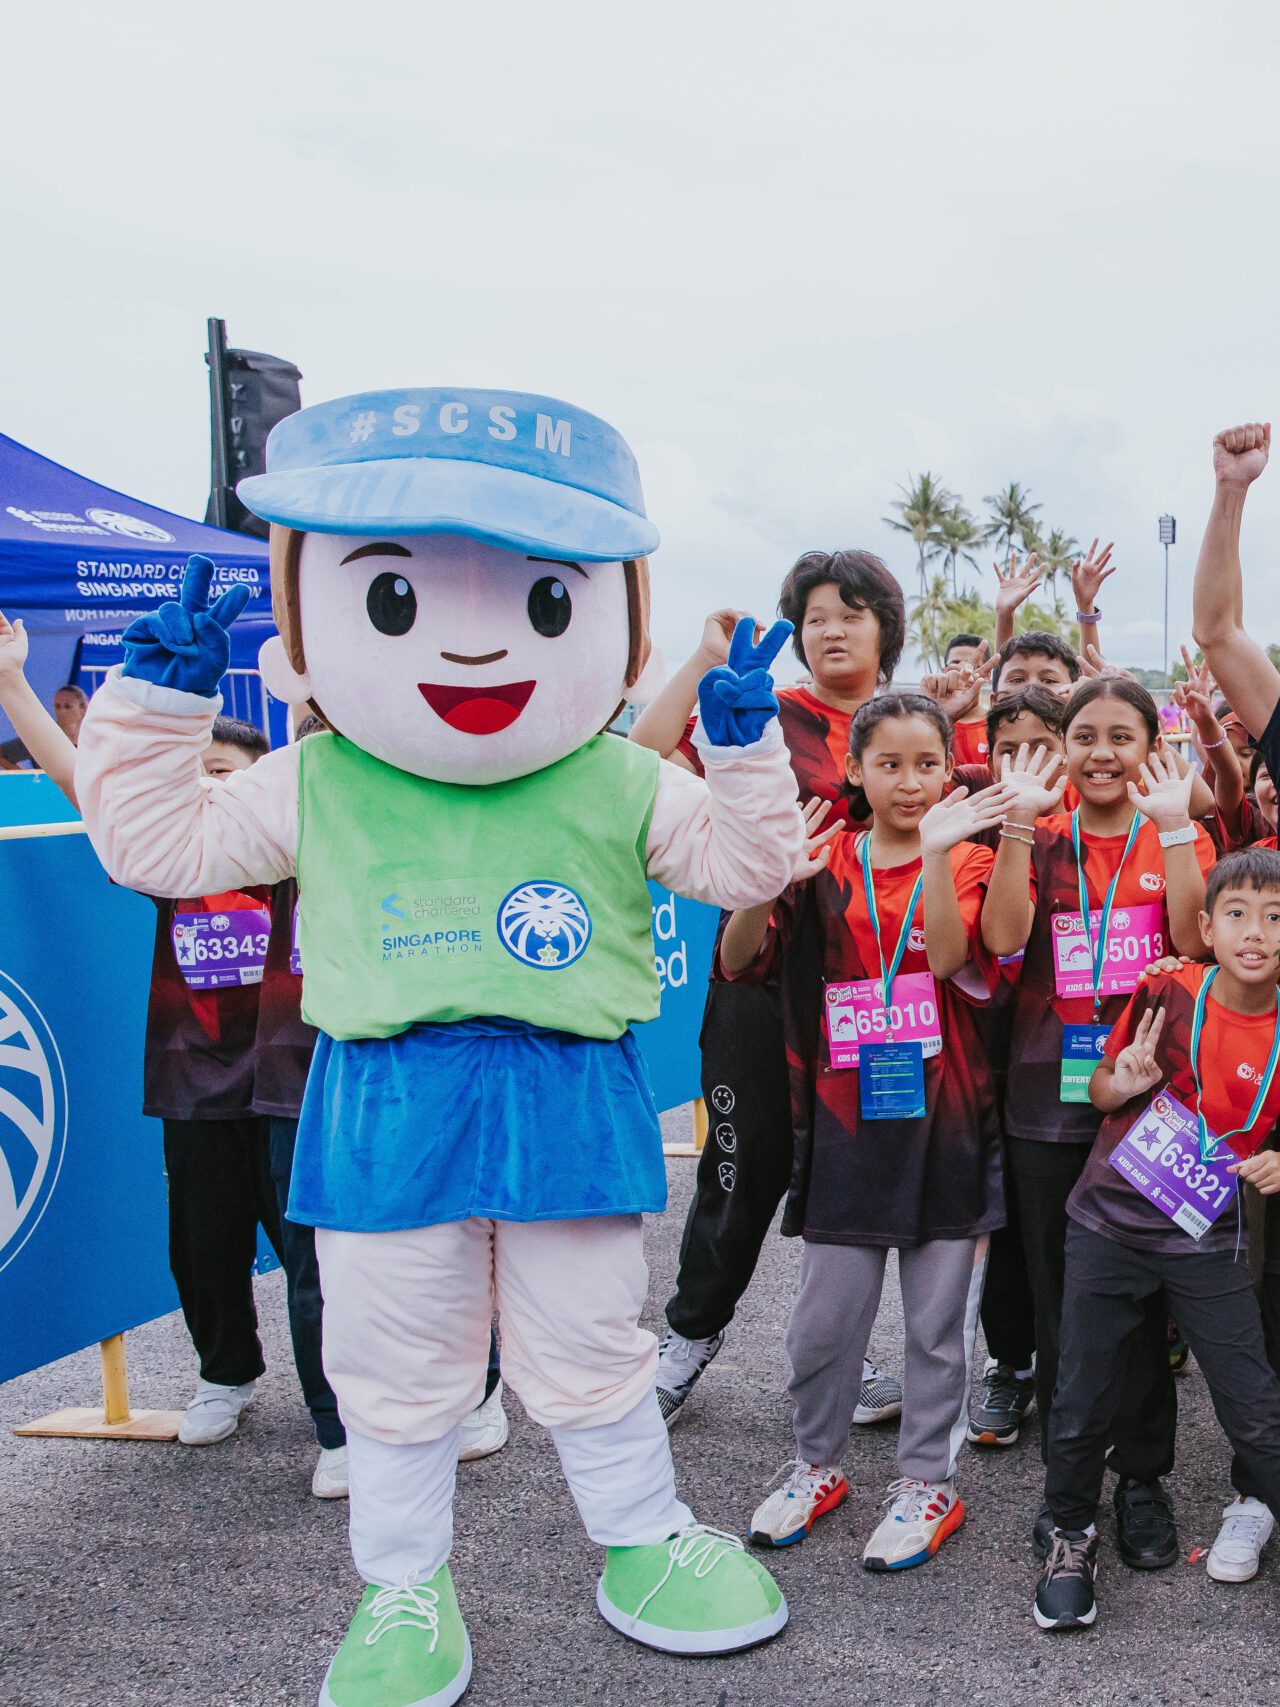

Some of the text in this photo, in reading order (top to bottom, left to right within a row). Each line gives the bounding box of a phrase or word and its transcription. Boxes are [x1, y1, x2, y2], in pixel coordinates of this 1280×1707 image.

[349, 402, 573, 457] #SCSM
[76, 561, 260, 583] STANDARD CHTERED
[76, 582, 178, 598] SINGAPORE
[413, 894, 476, 907] standard
[414, 904, 481, 920] chartered
[194, 933, 270, 962] 63343
[382, 929, 482, 951] SINGAPORE
[382, 944, 482, 961] MARATHON
[1065, 981, 1104, 992] KIDS DAH
[856, 1000, 936, 1035] 65010
[1117, 1155, 1150, 1186] KIDS DASH
[1160, 1142, 1231, 1209] 63321
